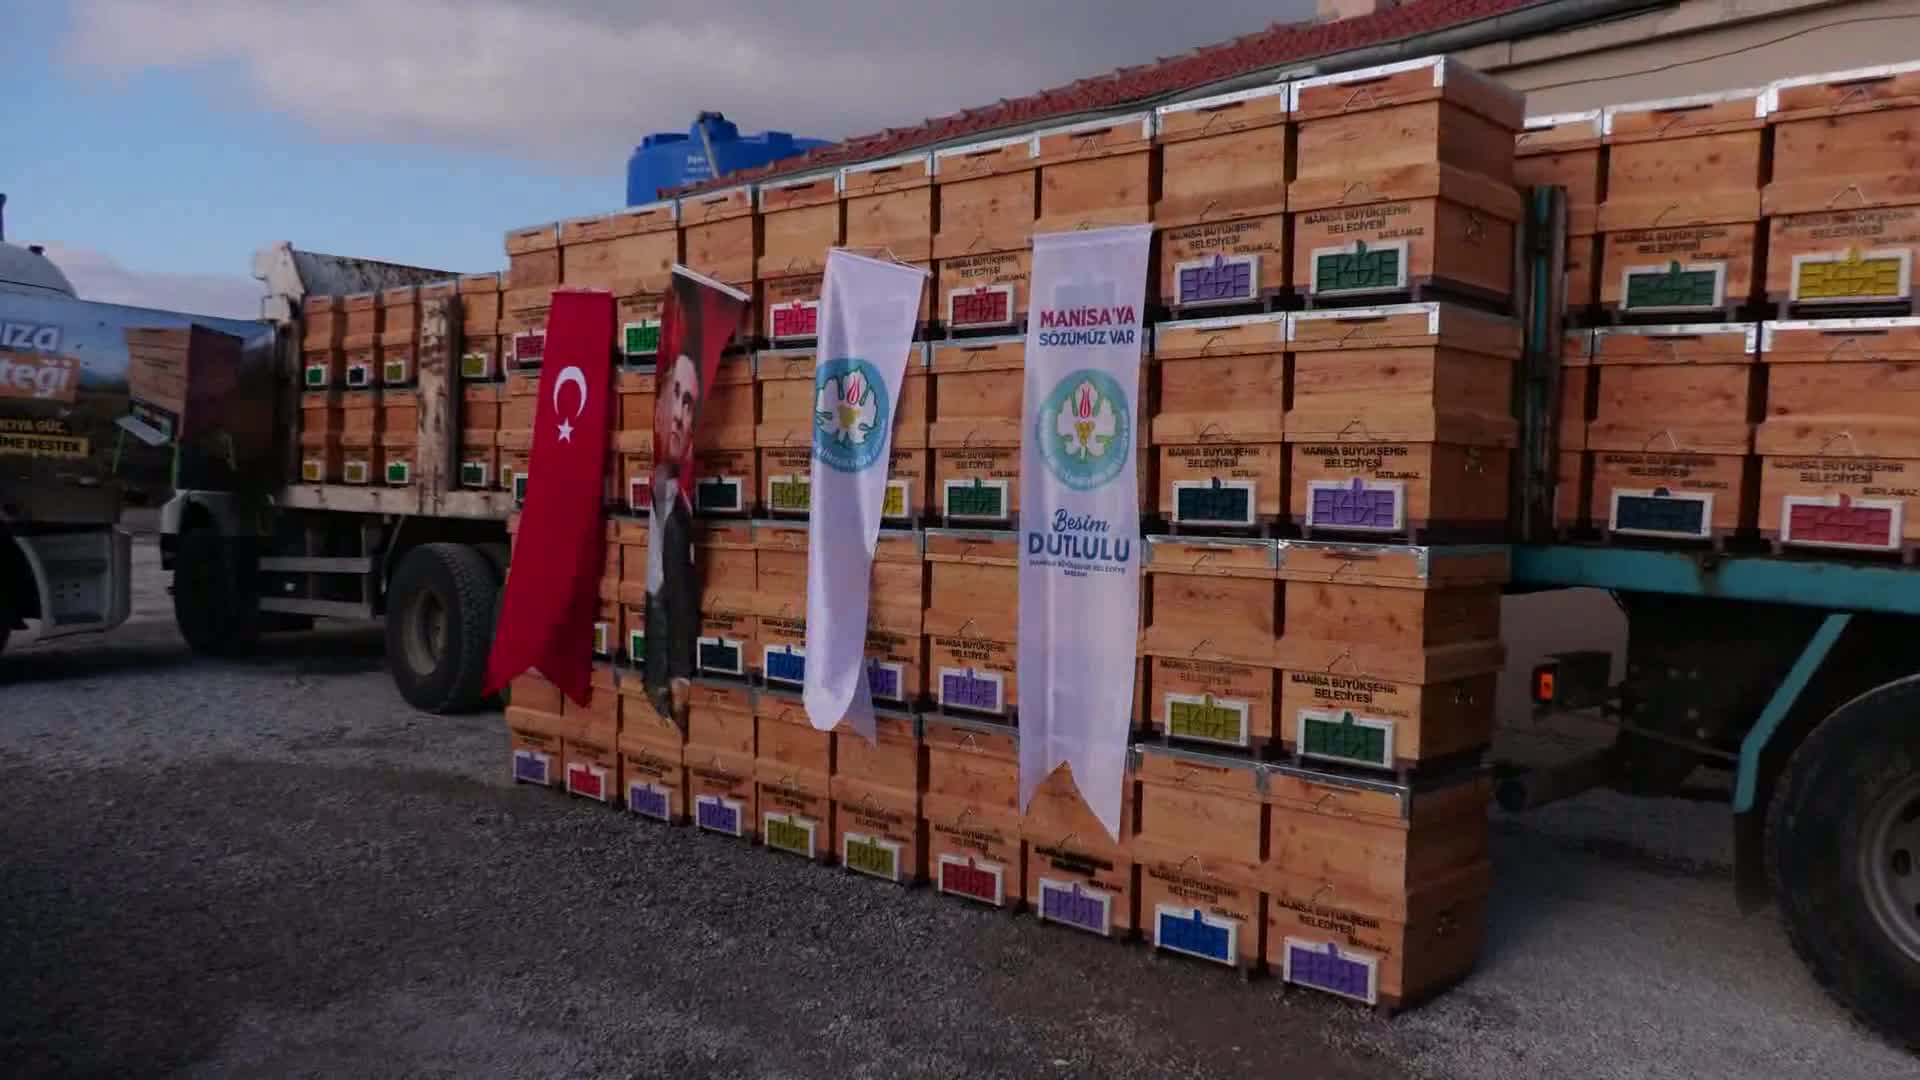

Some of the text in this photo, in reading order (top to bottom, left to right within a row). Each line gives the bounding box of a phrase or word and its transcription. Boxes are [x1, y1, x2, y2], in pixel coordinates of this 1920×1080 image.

[1040, 306, 1135, 328] MANİSA'YA
[1039, 328, 1134, 346] SÖZÜMÜZ VAR
[1053, 508, 1110, 532] Besim
[1028, 531, 1130, 562] DUTLULU
